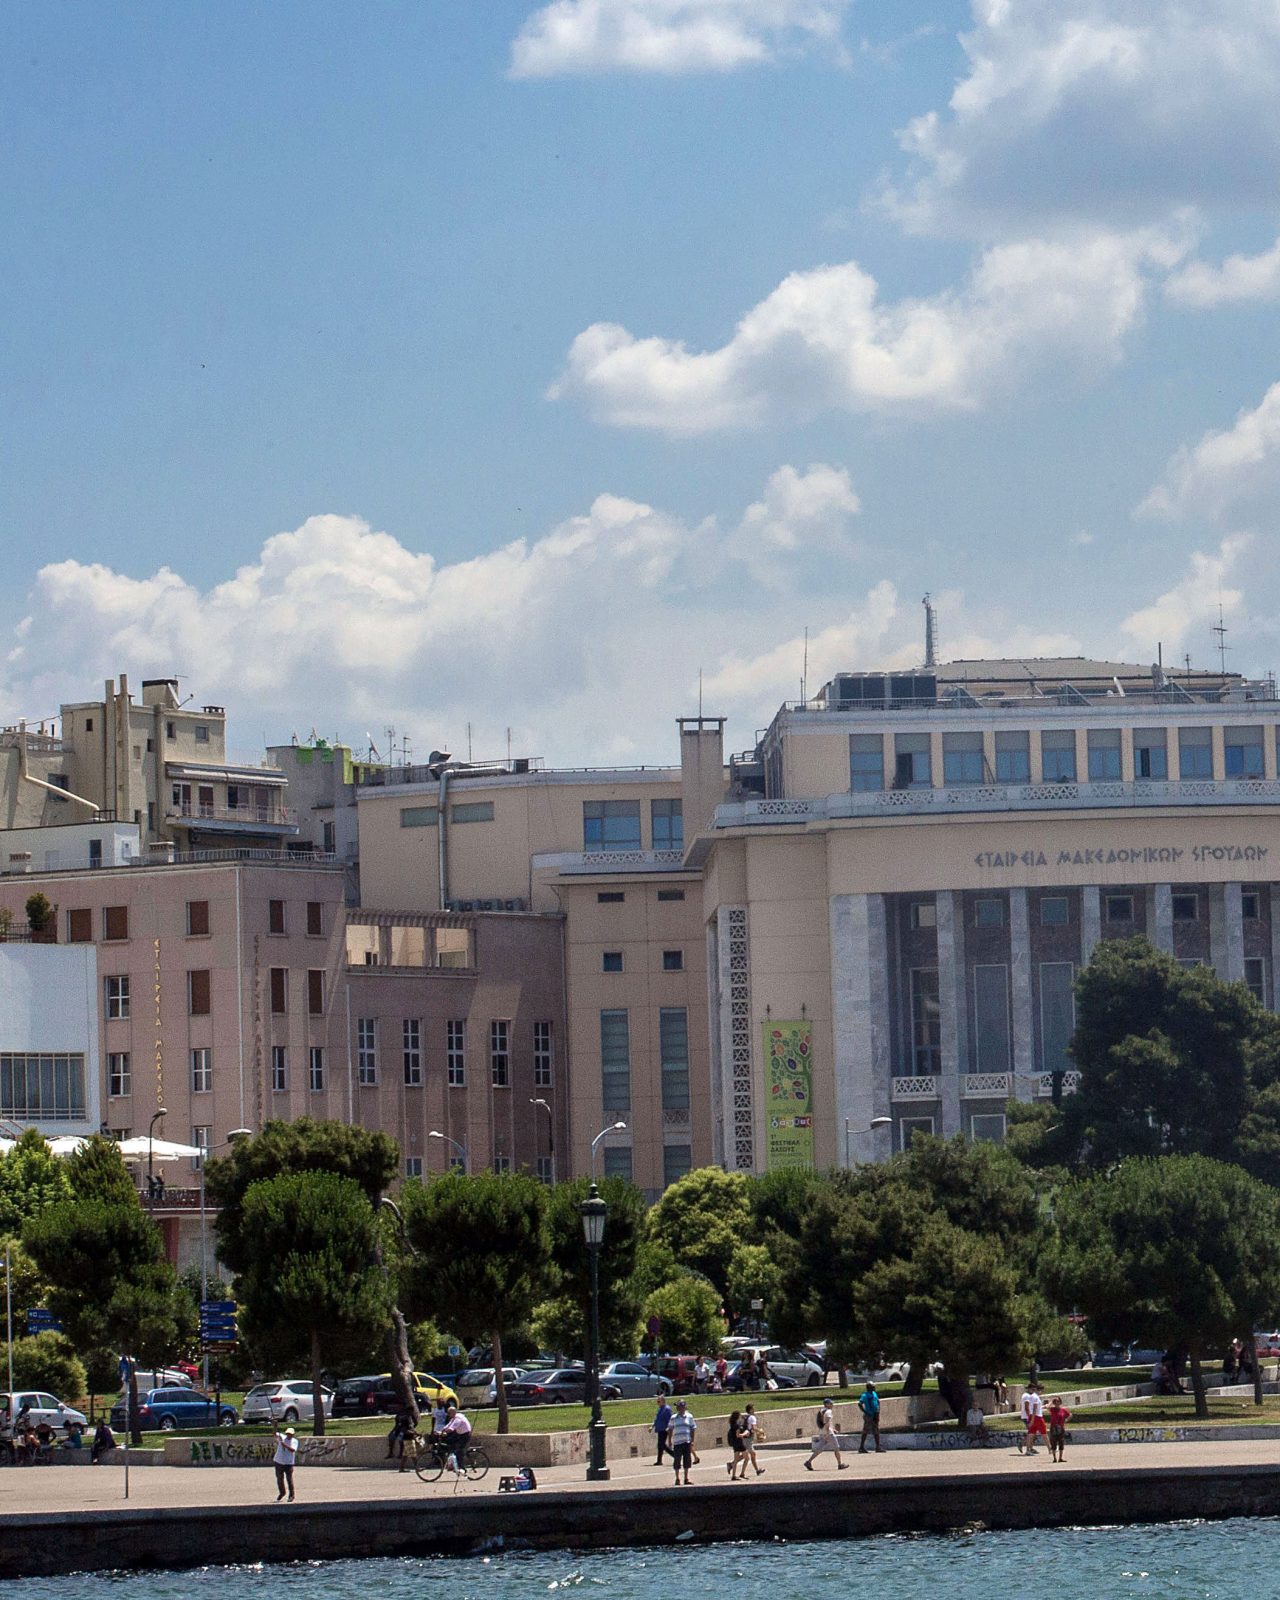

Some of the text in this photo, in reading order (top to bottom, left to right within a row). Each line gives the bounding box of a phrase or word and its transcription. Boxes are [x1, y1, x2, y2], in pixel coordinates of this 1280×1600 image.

[974, 850, 1048, 867] ΕΤΑΙΡΕΙΑ
[1057, 847, 1184, 865] ΜΑΚΕΔΟΝΙΚΩΝ
[154, 938, 162, 1026] ΕΤΑΙΡΕΙΑ
